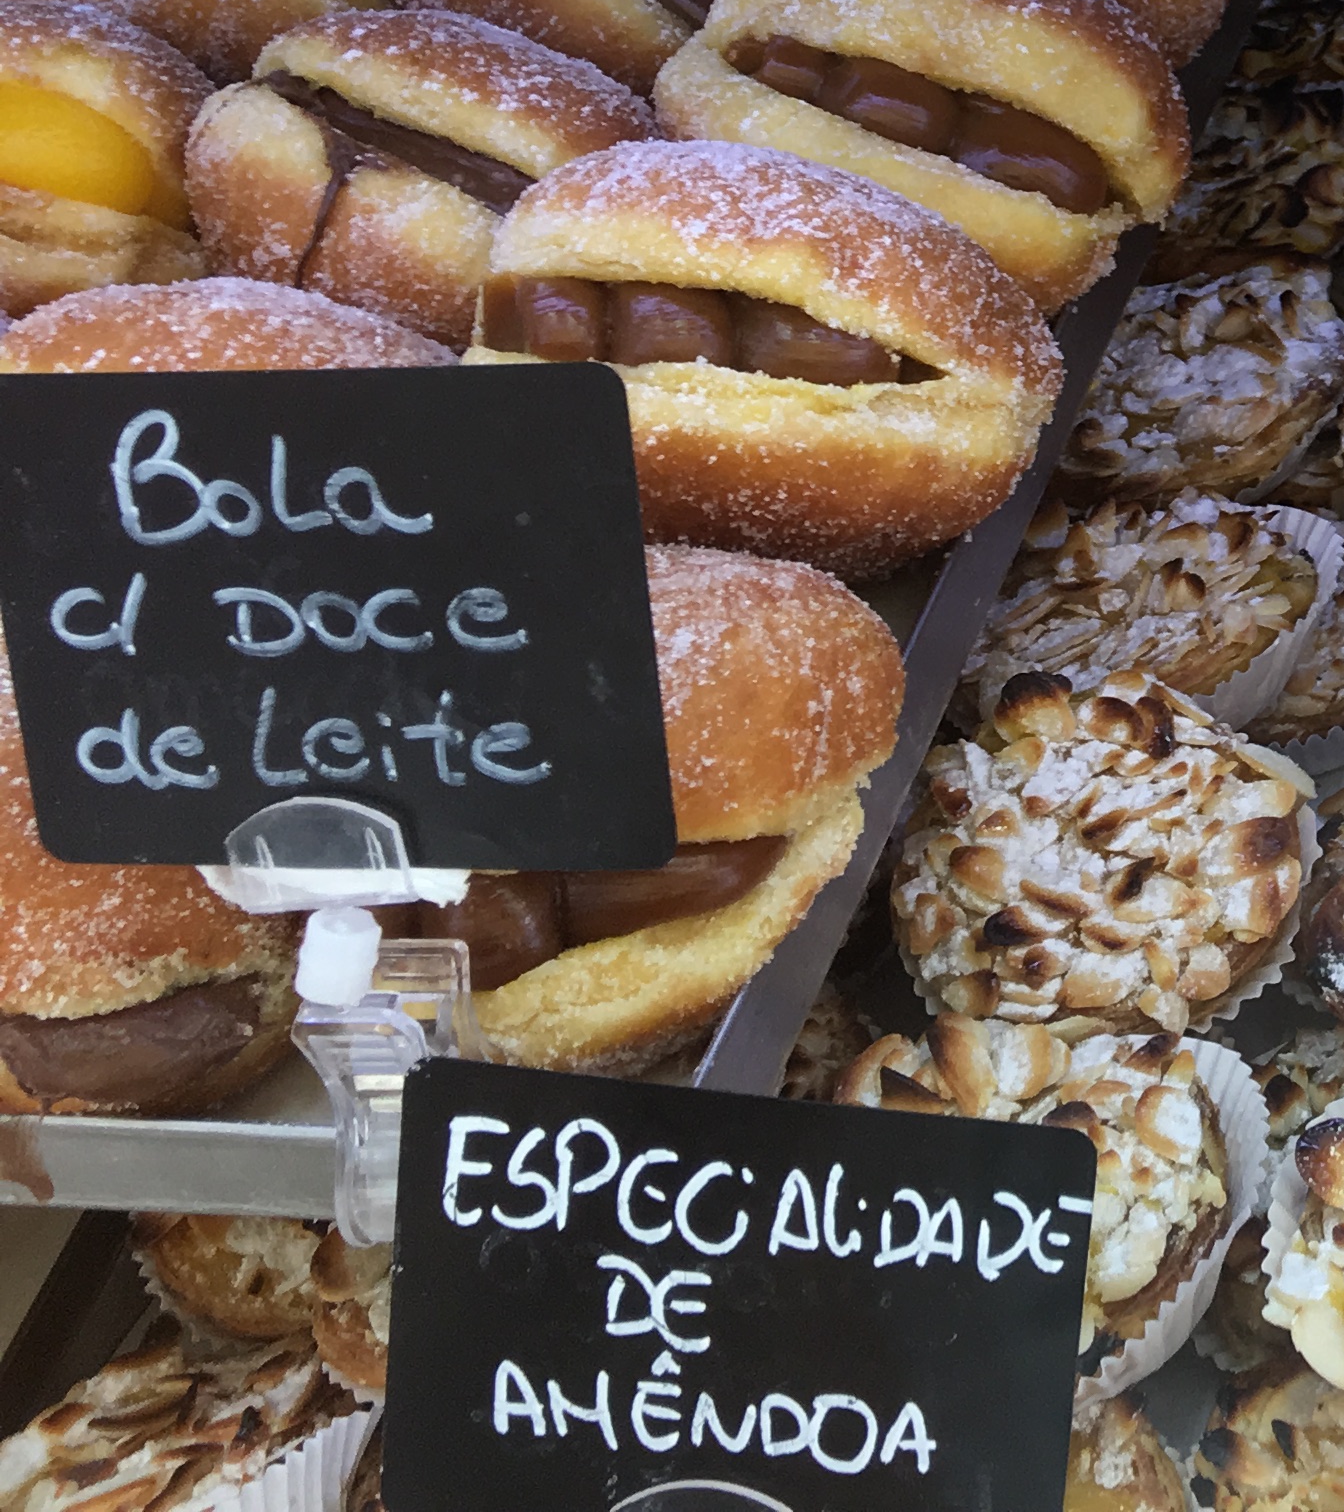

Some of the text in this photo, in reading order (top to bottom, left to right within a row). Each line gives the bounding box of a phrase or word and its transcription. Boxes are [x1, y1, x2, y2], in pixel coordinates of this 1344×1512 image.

[50, 572, 147, 656] c/
[76, 686, 553, 790] de Leite
[597, 1254, 713, 1354] DE
